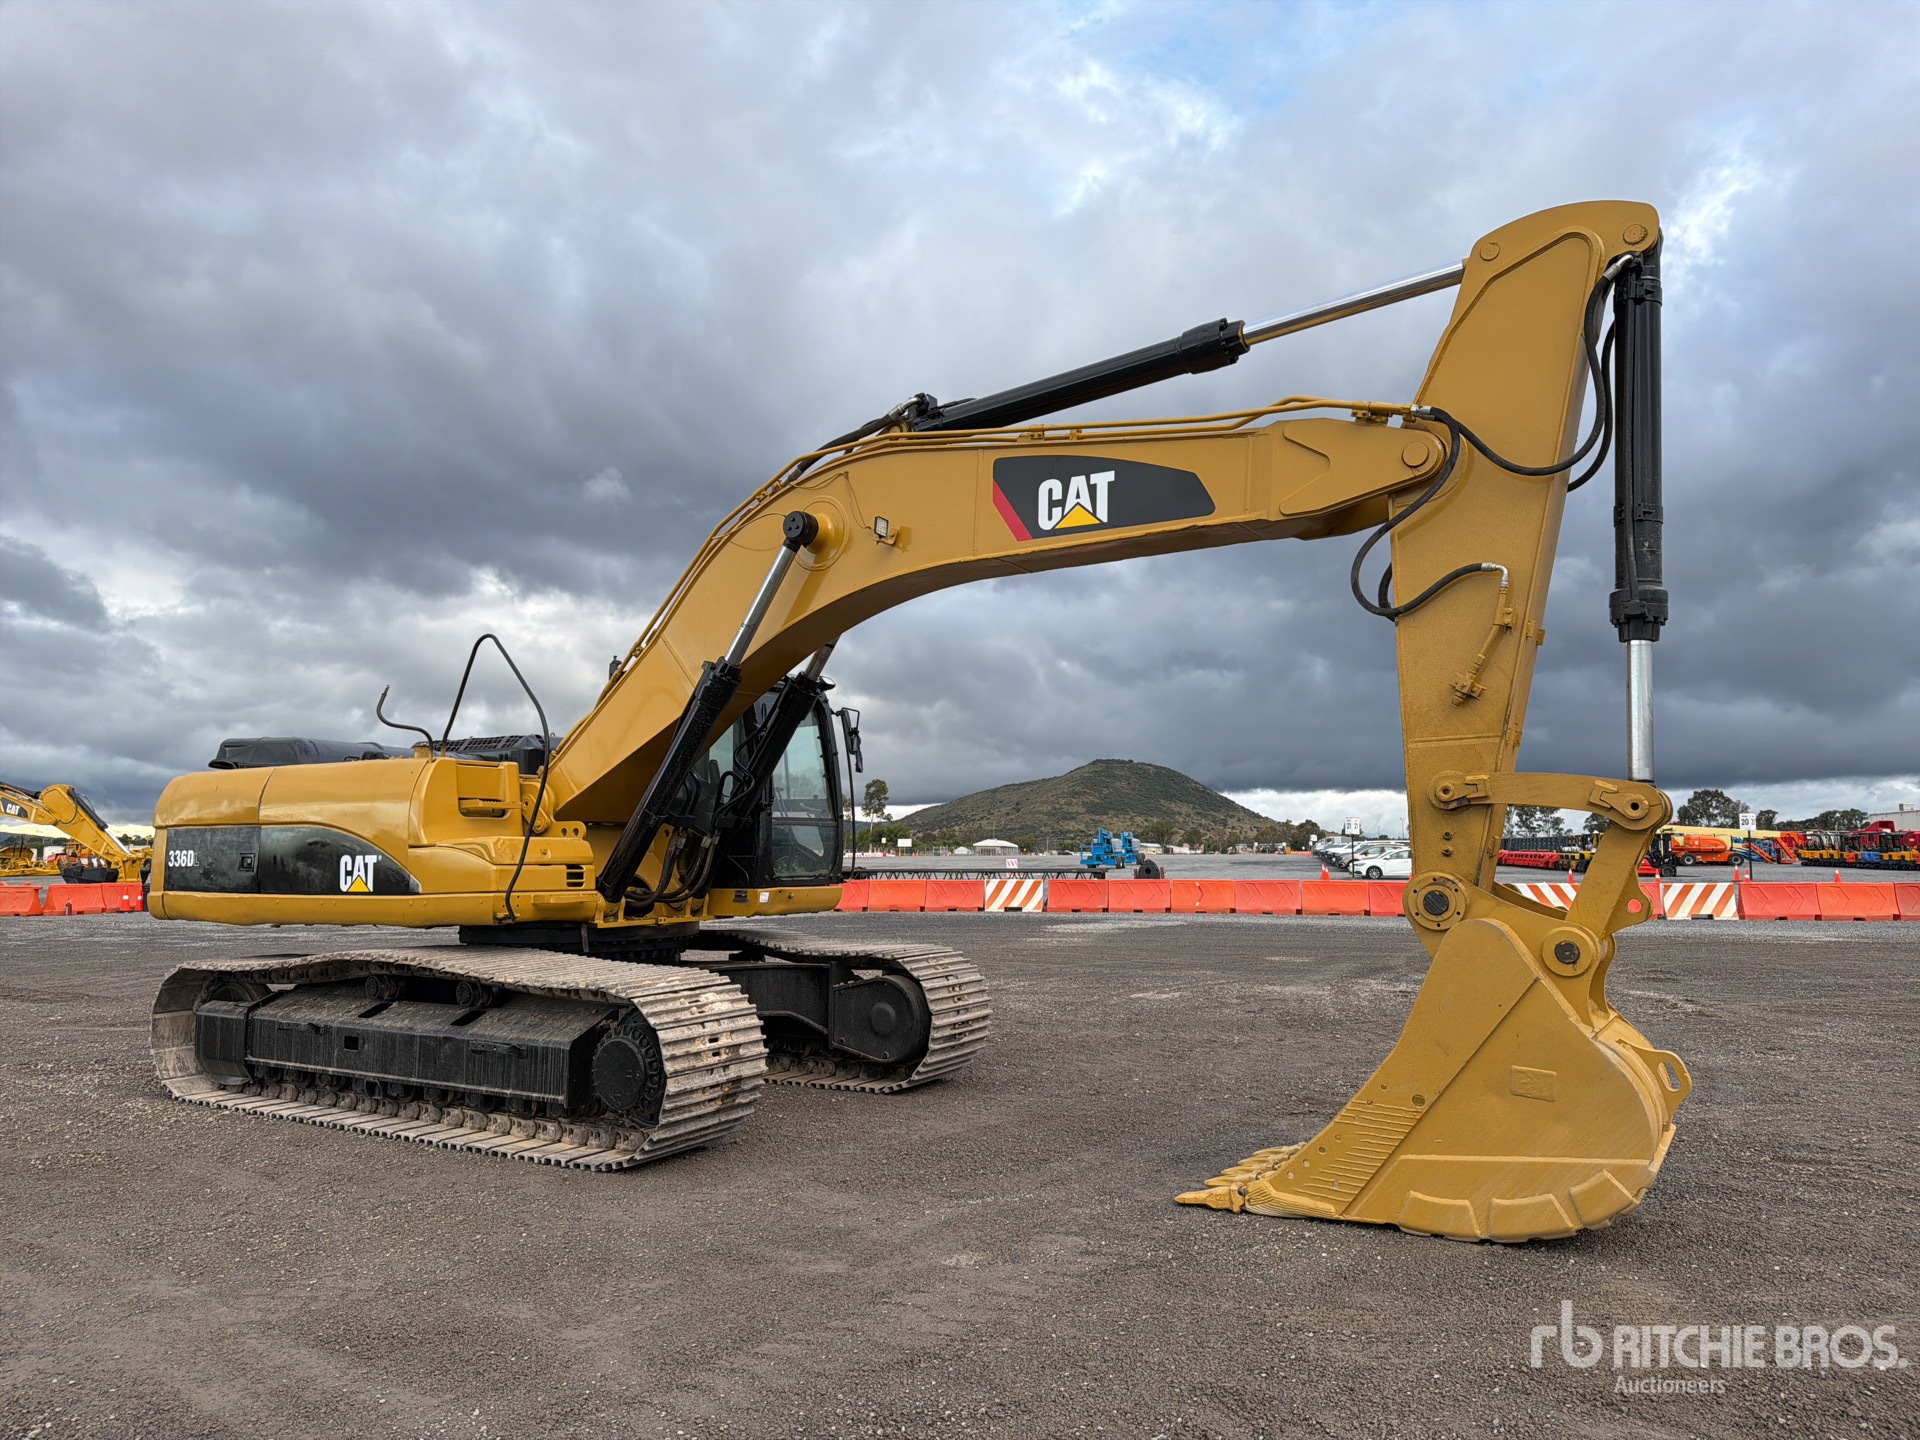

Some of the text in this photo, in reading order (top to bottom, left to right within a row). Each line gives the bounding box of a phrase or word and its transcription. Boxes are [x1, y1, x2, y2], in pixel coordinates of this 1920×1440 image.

[1038, 470, 1115, 531] CAT
[6, 803, 20, 815] CAT
[1741, 818, 1749, 826] 20
[339, 854, 377, 892] CAT
